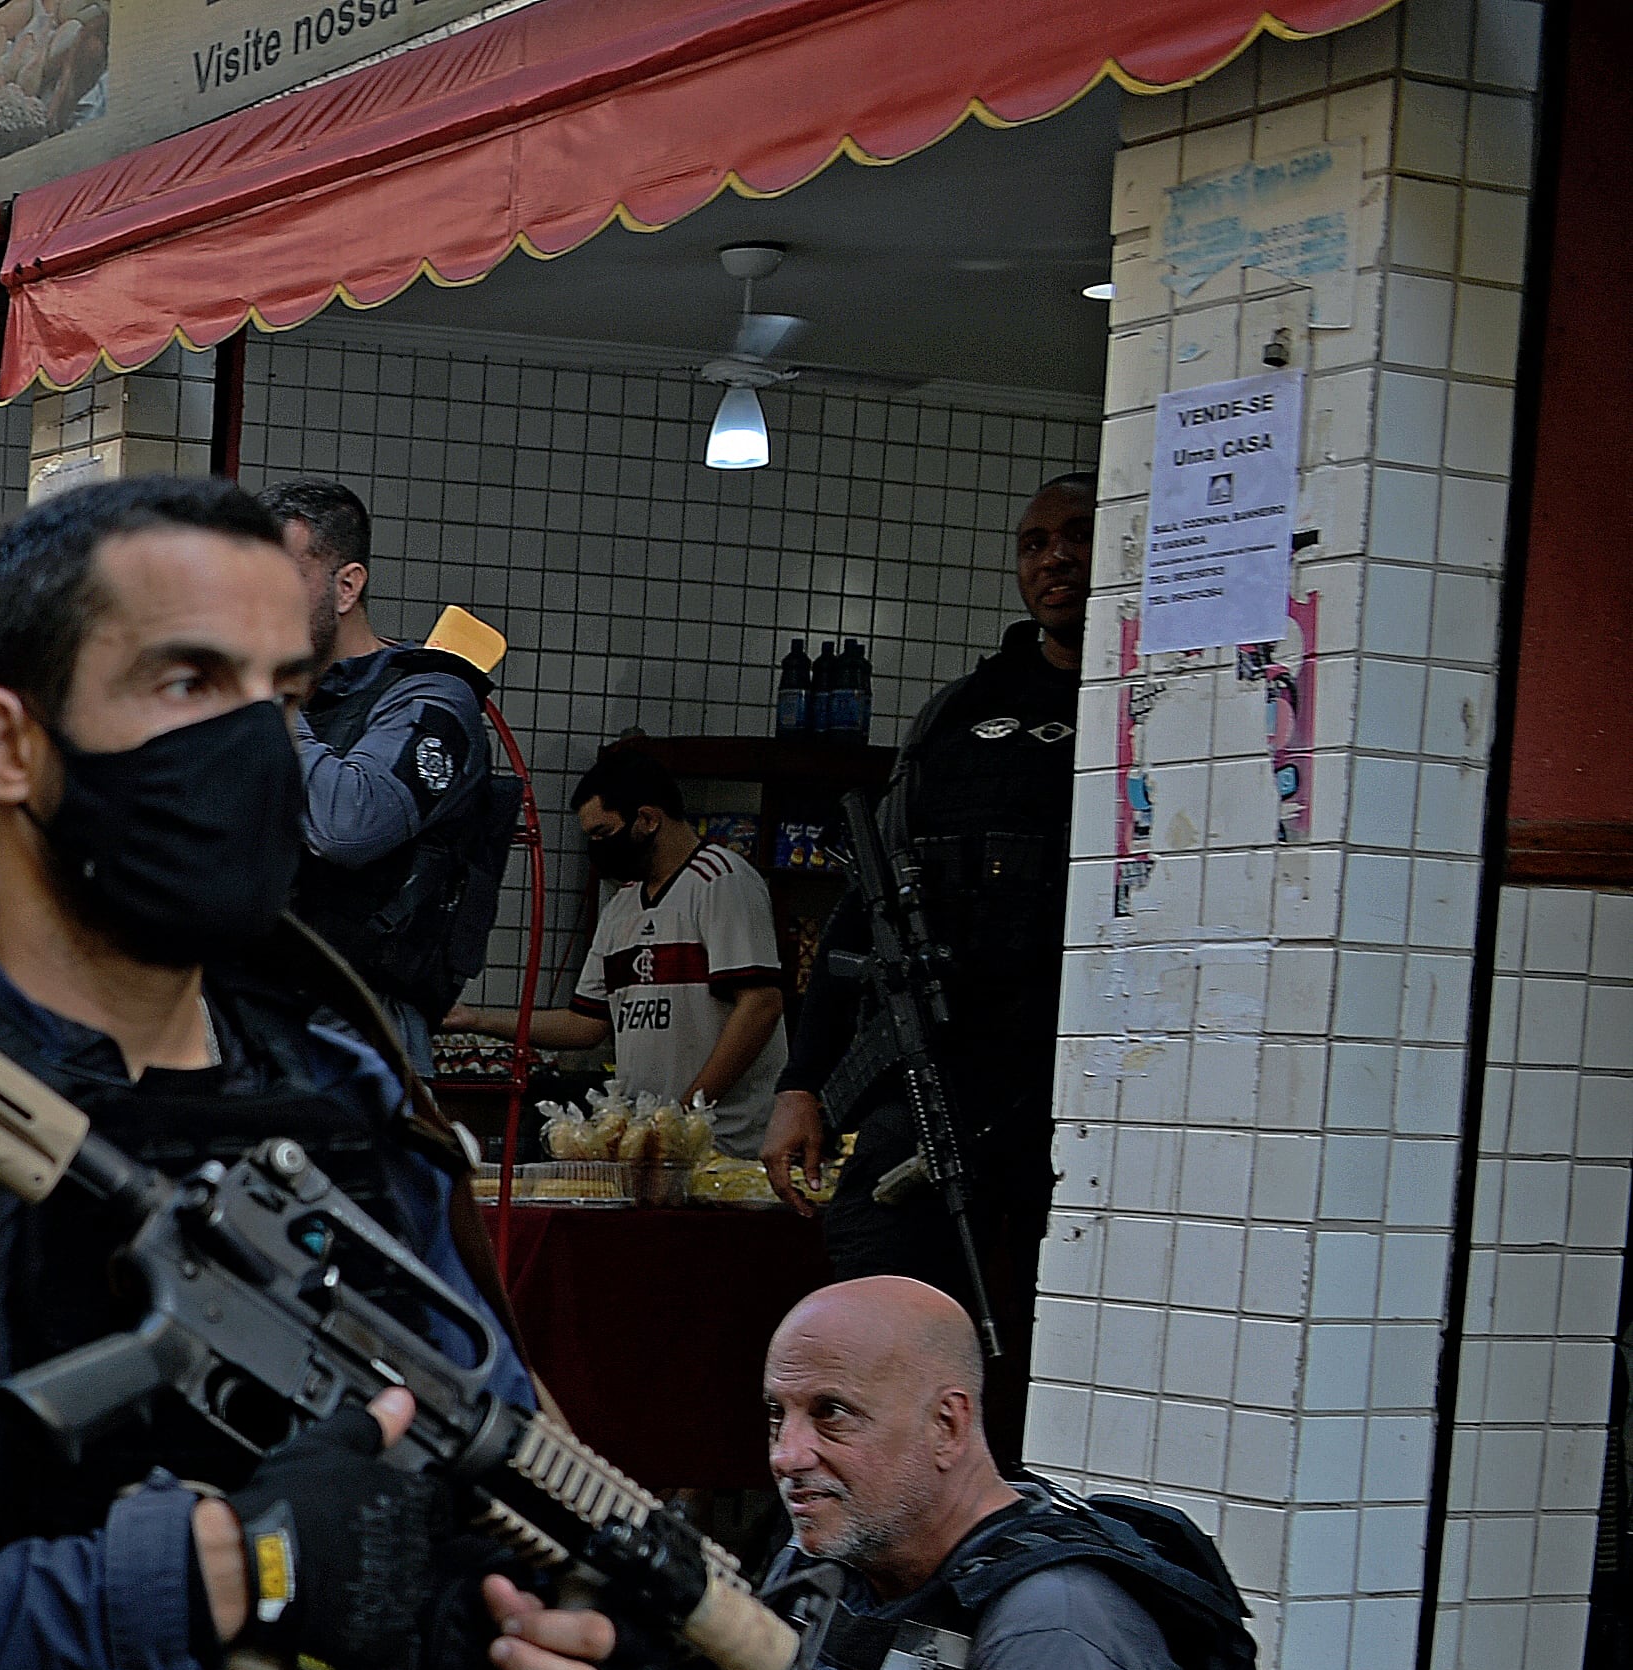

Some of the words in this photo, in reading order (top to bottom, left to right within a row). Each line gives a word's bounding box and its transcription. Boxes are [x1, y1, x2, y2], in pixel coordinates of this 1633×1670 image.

[192, 29, 281, 94] Visite
[294, 0, 397, 55] nossa
[1177, 394, 1274, 428] VENDE-SE
[1222, 433, 1273, 459] CASA
